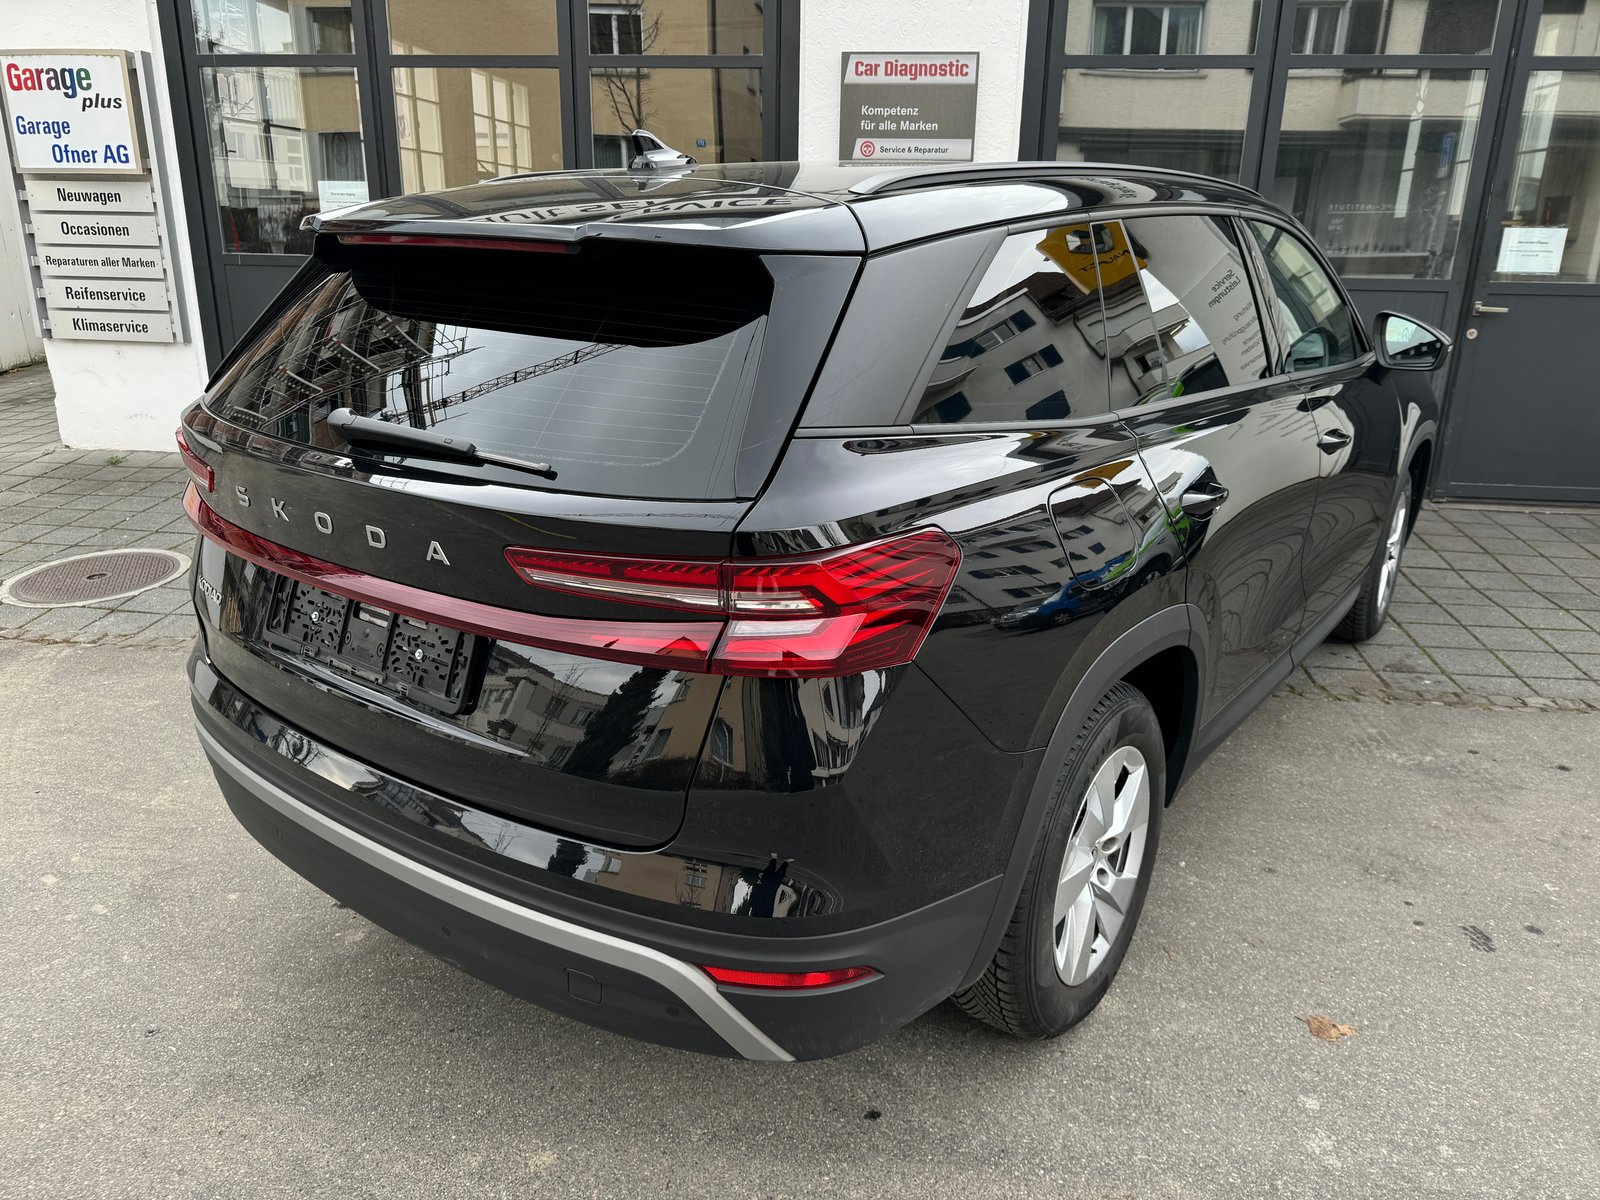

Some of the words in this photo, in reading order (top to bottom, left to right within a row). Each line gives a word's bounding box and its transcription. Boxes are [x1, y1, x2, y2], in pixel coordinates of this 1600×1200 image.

[854, 61, 880, 77] Car
[884, 59, 969, 81] Diagnostic
[6, 63, 92, 99] Garage
[82, 93, 122, 112] plus
[861, 105, 919, 118] Kompetenz
[15, 115, 71, 139] Garage
[860, 120, 876, 131] für
[878, 120, 897, 131] alle
[900, 120, 938, 131] Marken
[51, 143, 98, 164] Ofner
[103, 144, 130, 164] AG
[880, 146, 906, 154] Service
[914, 146, 949, 155] Reparatur
[56, 188, 122, 205] Neuwagen
[60, 221, 130, 236] Occasionen
[45, 255, 99, 268] Reparaturen
[101, 257, 120, 268] aller
[121, 257, 156, 268] Marken
[65, 286, 146, 301] Reifenservice
[72, 318, 149, 333] Klimaservice
[235, 485, 450, 566] SKODA
